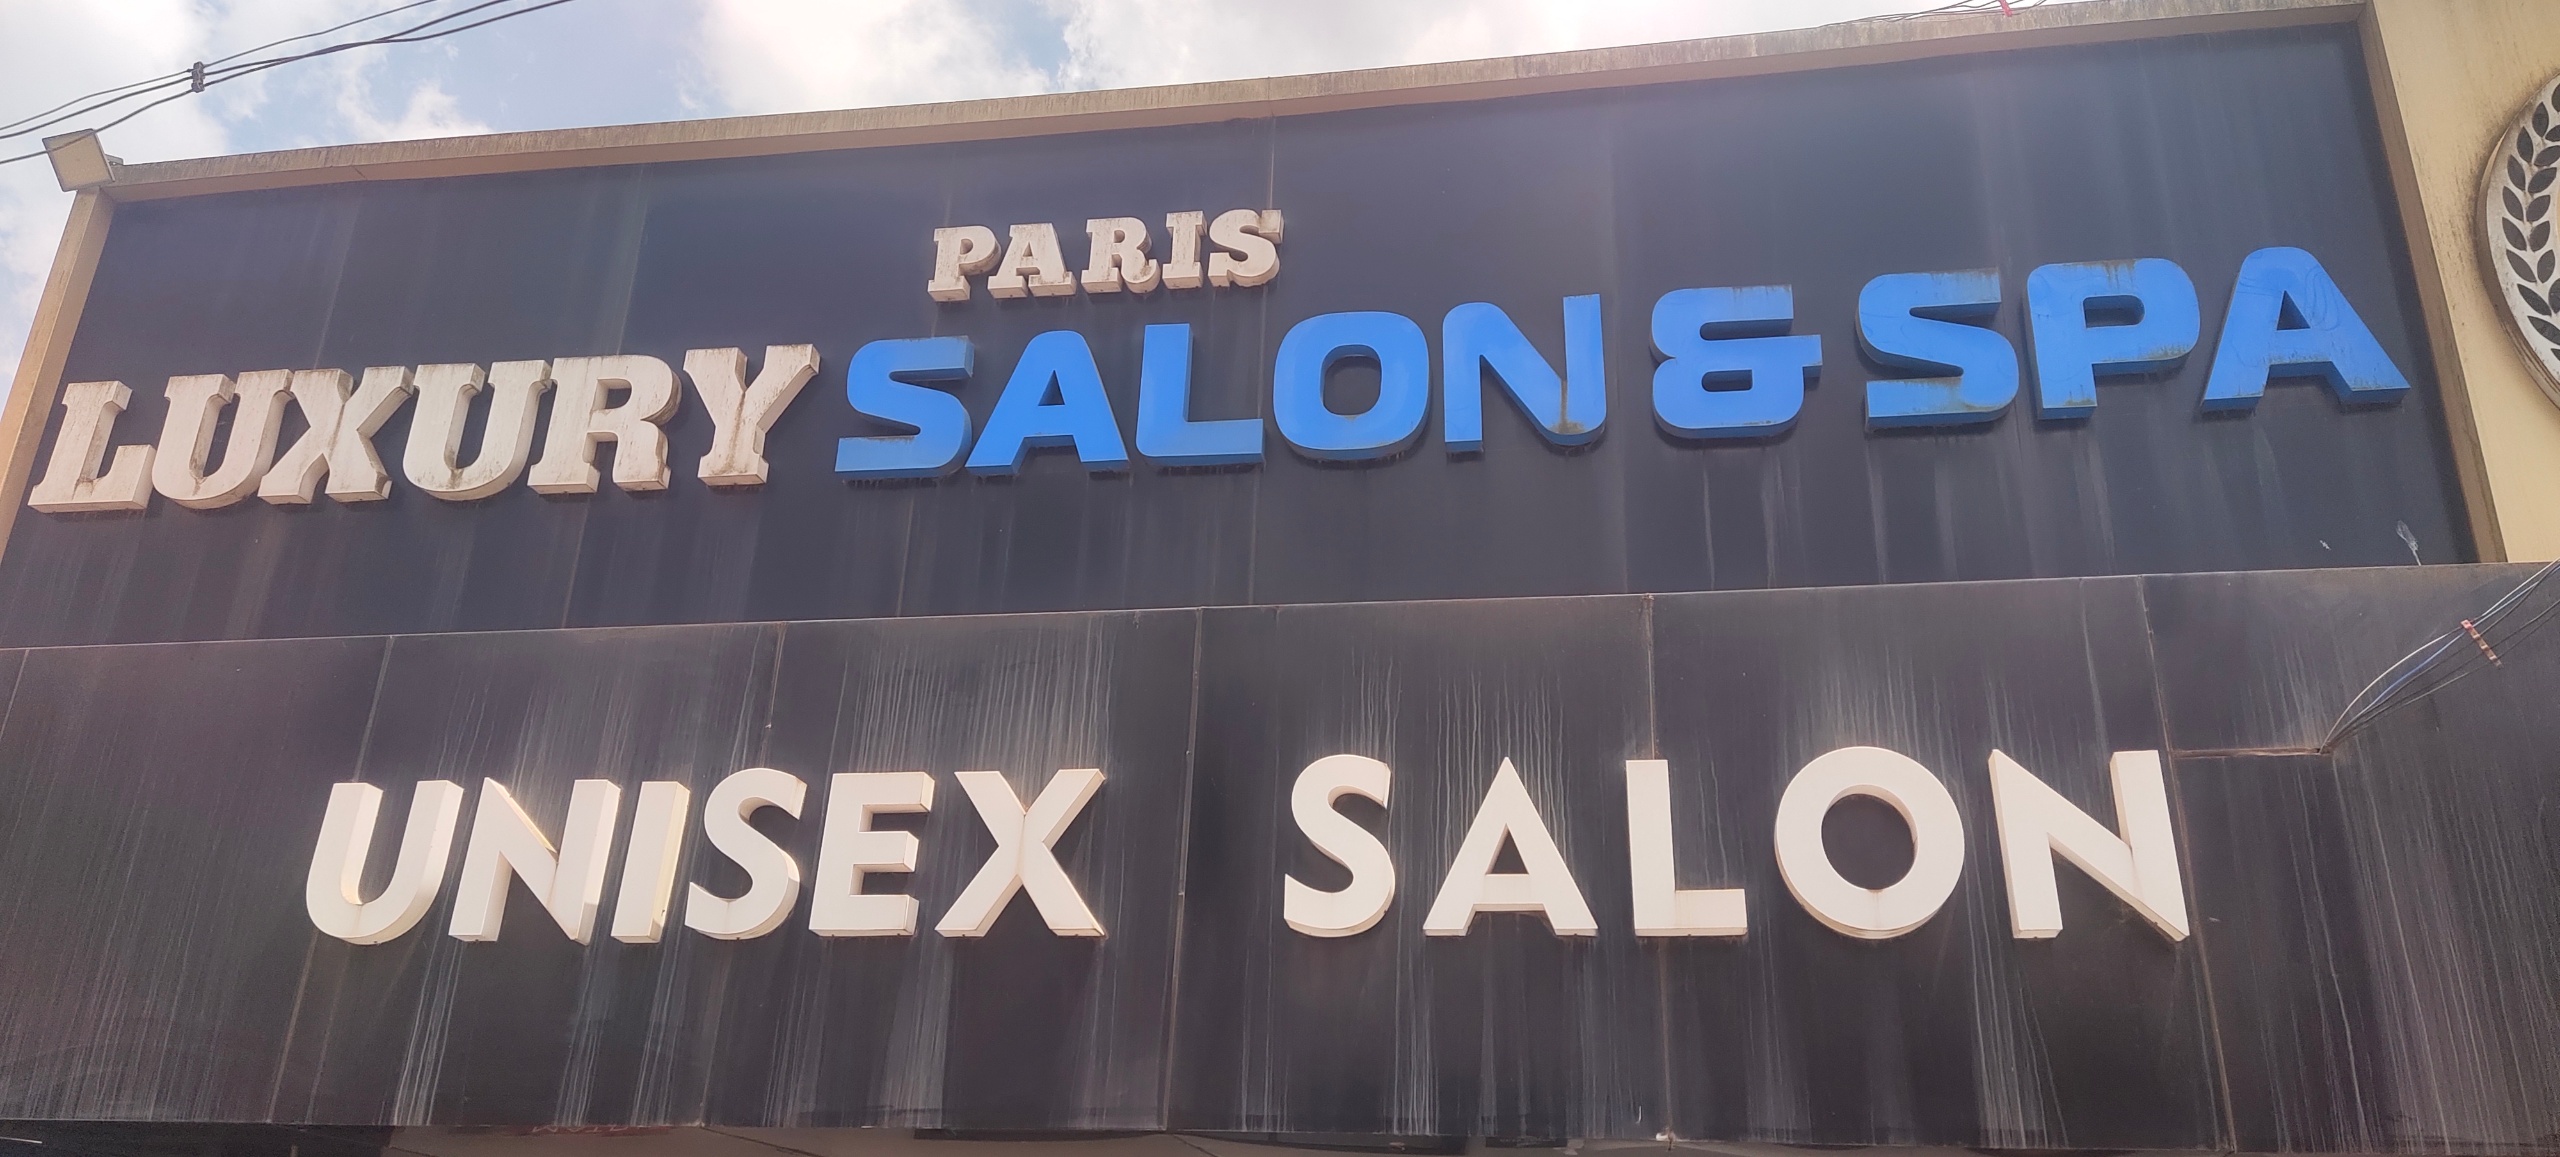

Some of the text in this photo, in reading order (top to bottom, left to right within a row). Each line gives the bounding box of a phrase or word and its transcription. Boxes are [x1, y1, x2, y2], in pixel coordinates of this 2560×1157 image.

[928, 209, 1284, 301] PARIS
[28, 246, 2411, 514] LUXURY SALON & SPA
[305, 746, 2189, 946] UNISEX SALON
